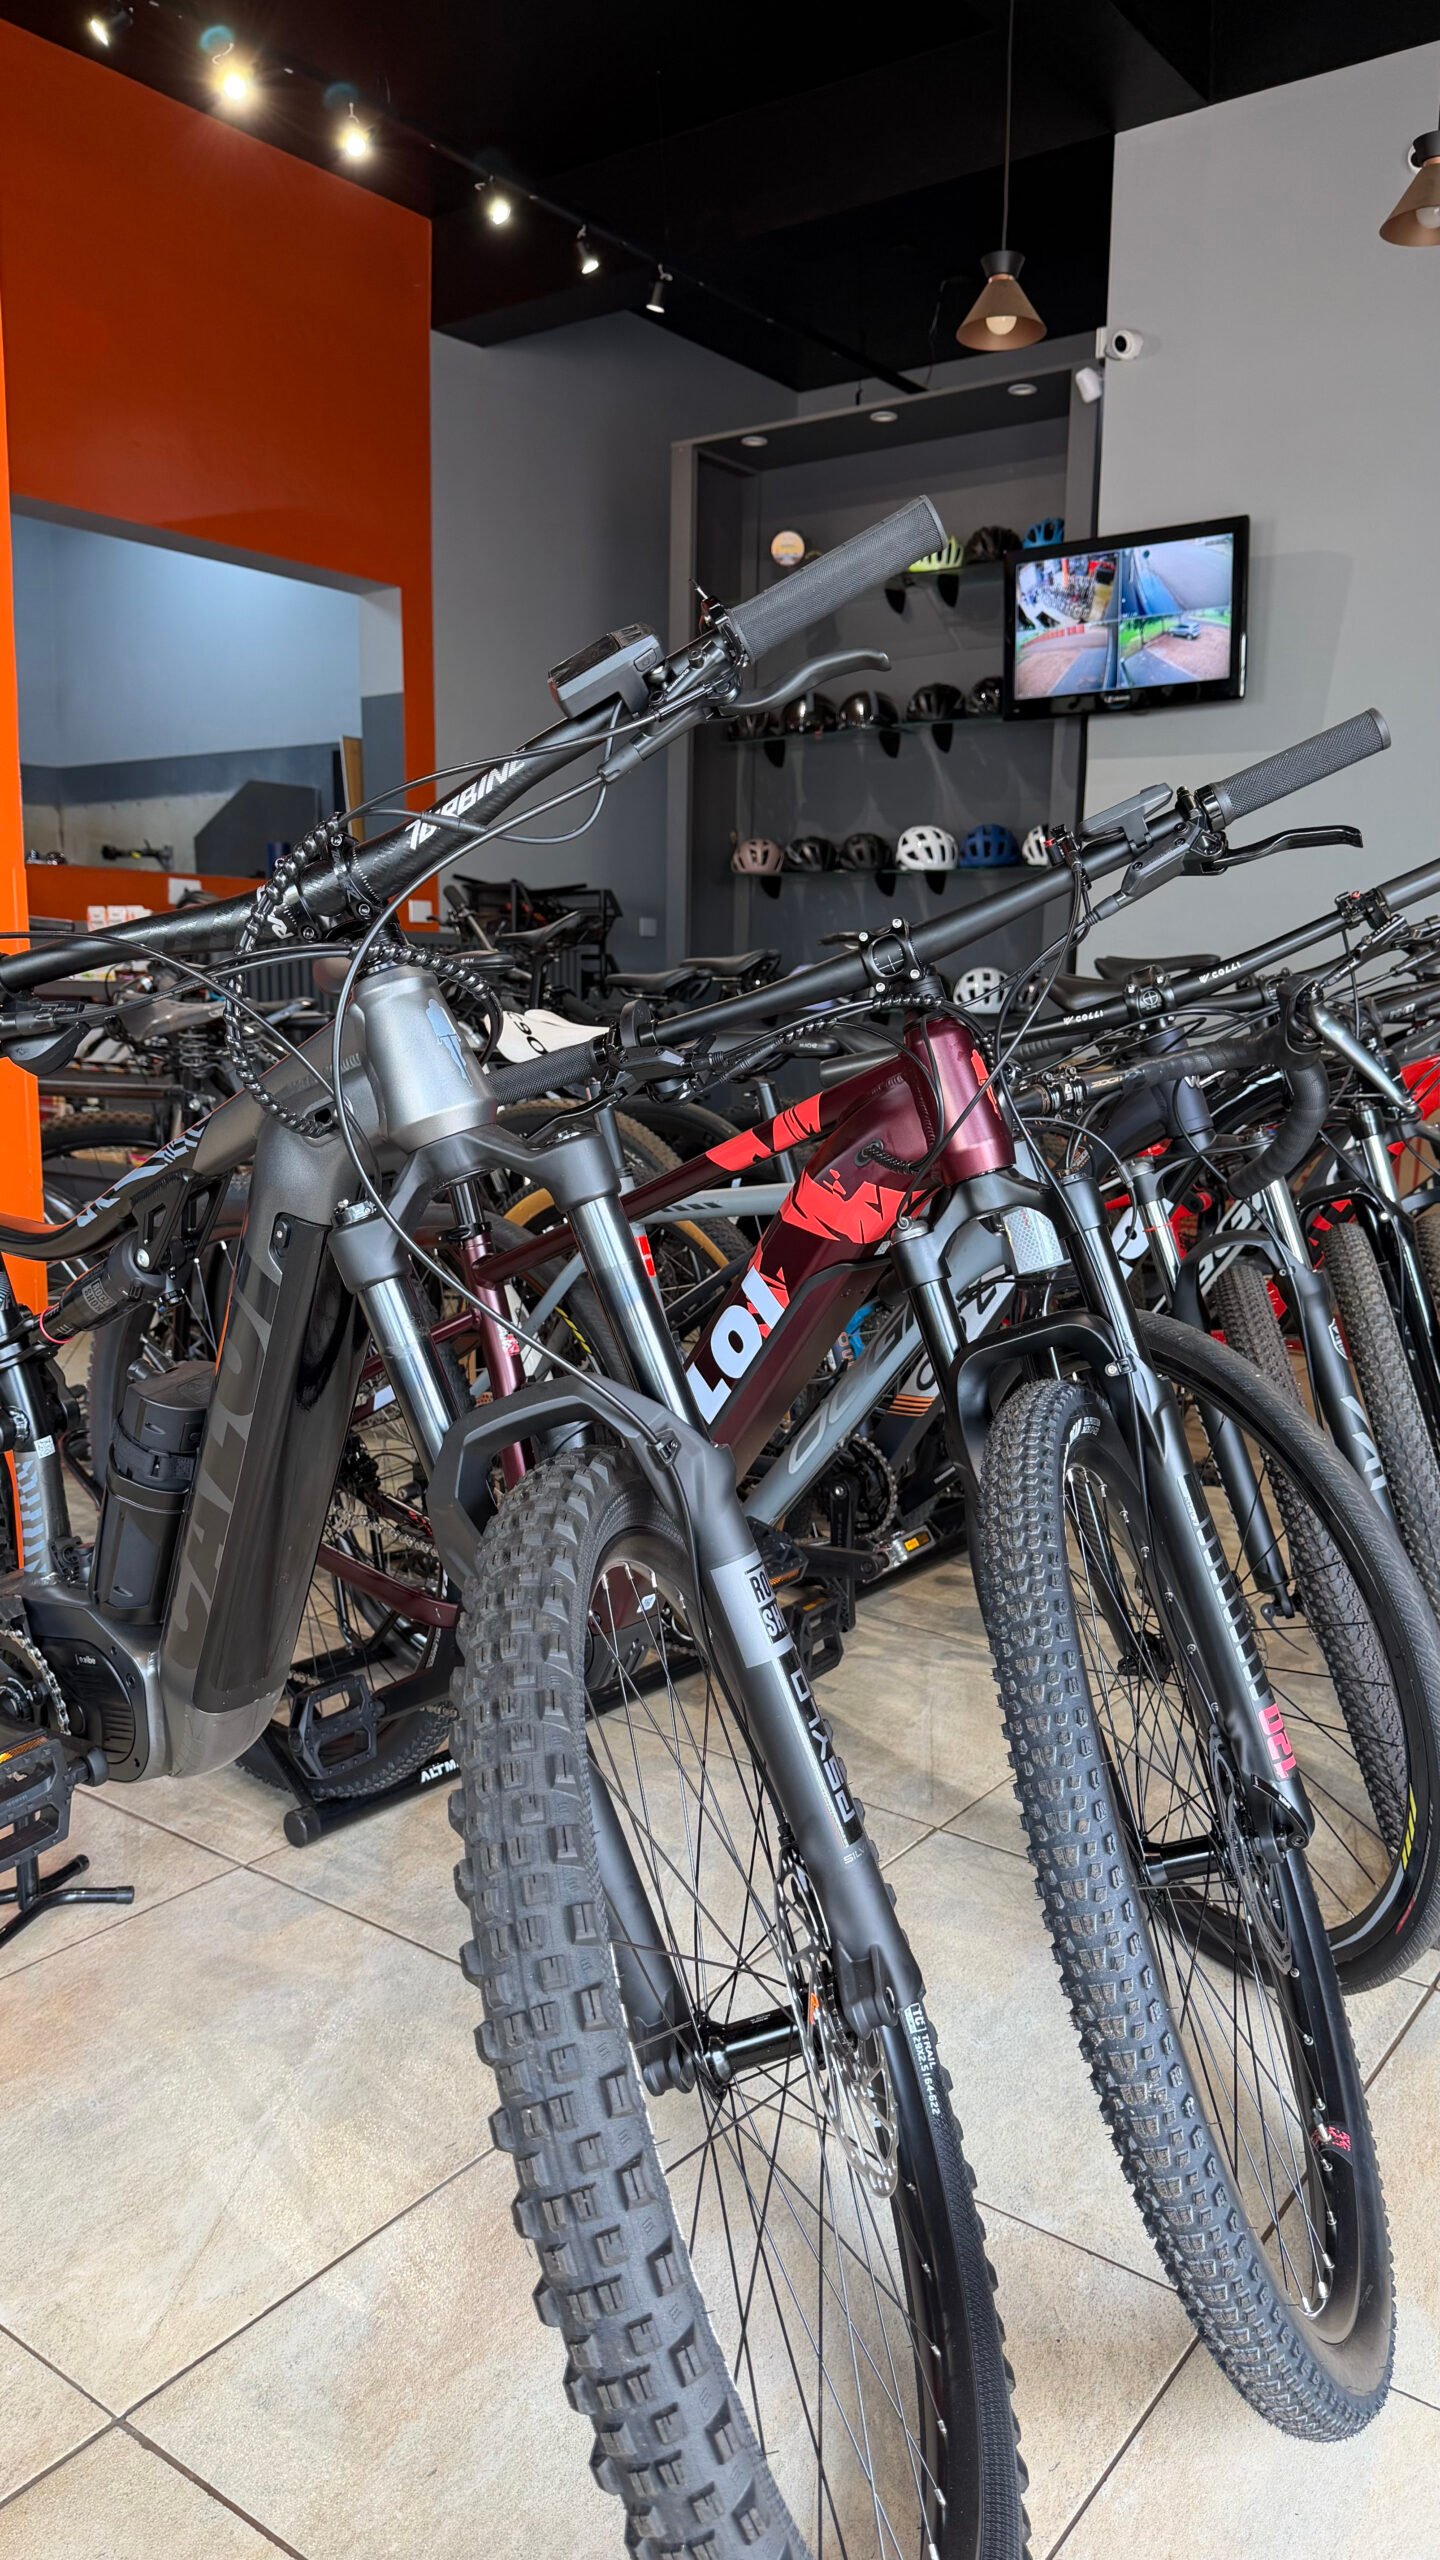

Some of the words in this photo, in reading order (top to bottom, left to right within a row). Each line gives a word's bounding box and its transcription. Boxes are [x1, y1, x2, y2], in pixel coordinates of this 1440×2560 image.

[1211, 962, 1242, 979] COLLI
[1075, 1010, 1104, 1022] COLLI
[83, 1286, 104, 1312] SHOX
[91, 1281, 113, 1307] ROCK
[684, 1266, 786, 1425] LOI
[750, 1568, 773, 1604] RO
[763, 1605, 788, 1639] SH
[1258, 1703, 1297, 1781] 120
[420, 1758, 459, 1783] ALTM
[843, 1848, 866, 1865] SILV
[921, 2033, 937, 2070] TRAIL
[924, 2077, 941, 2115] 64-622
